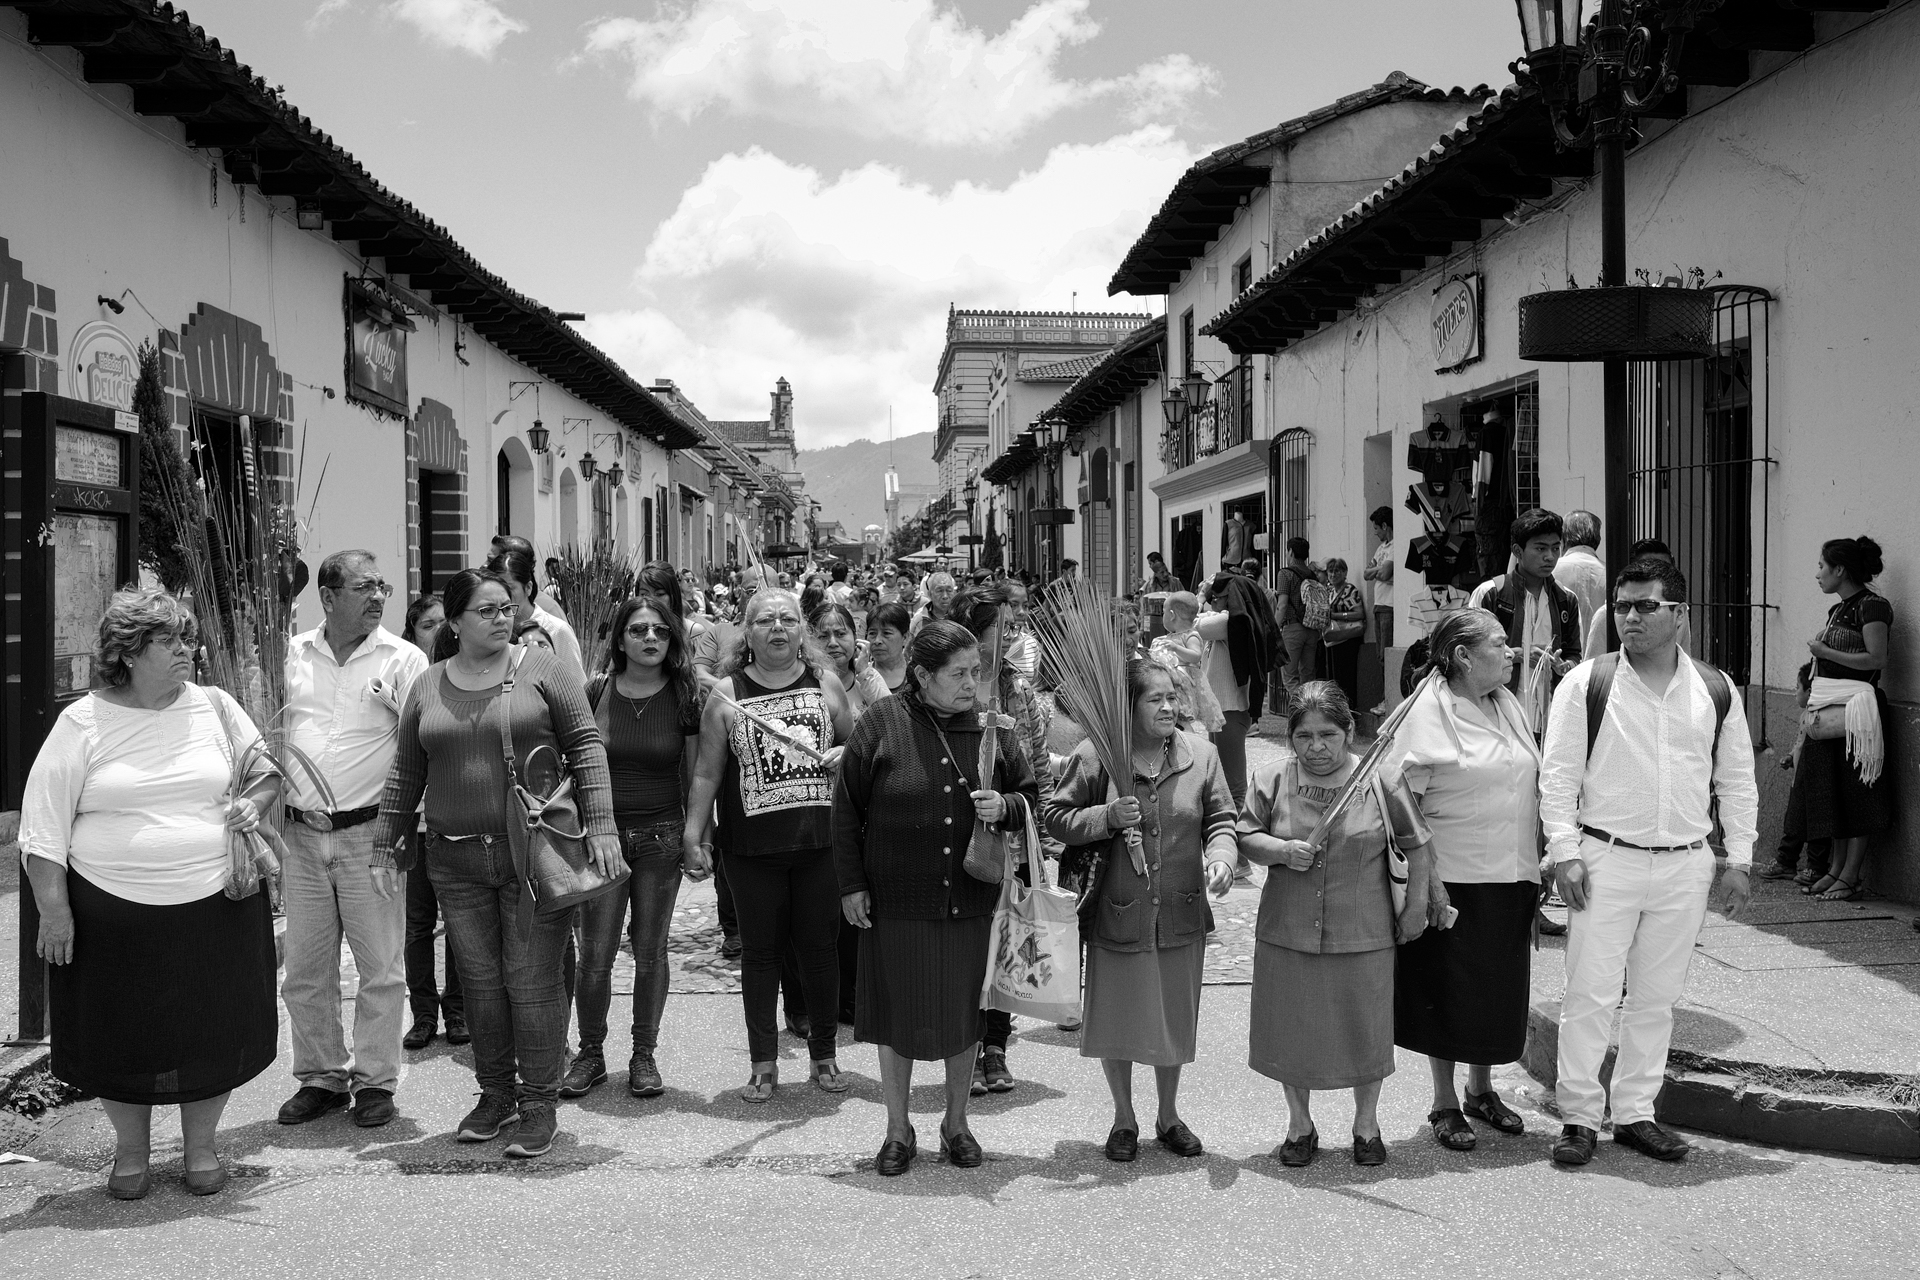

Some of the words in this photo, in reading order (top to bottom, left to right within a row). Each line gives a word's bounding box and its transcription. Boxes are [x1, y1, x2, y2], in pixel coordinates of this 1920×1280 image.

[364, 322, 396, 373] Lucky
[1435, 289, 1468, 360] RIVERS
[99, 353, 121, 373] Helados
